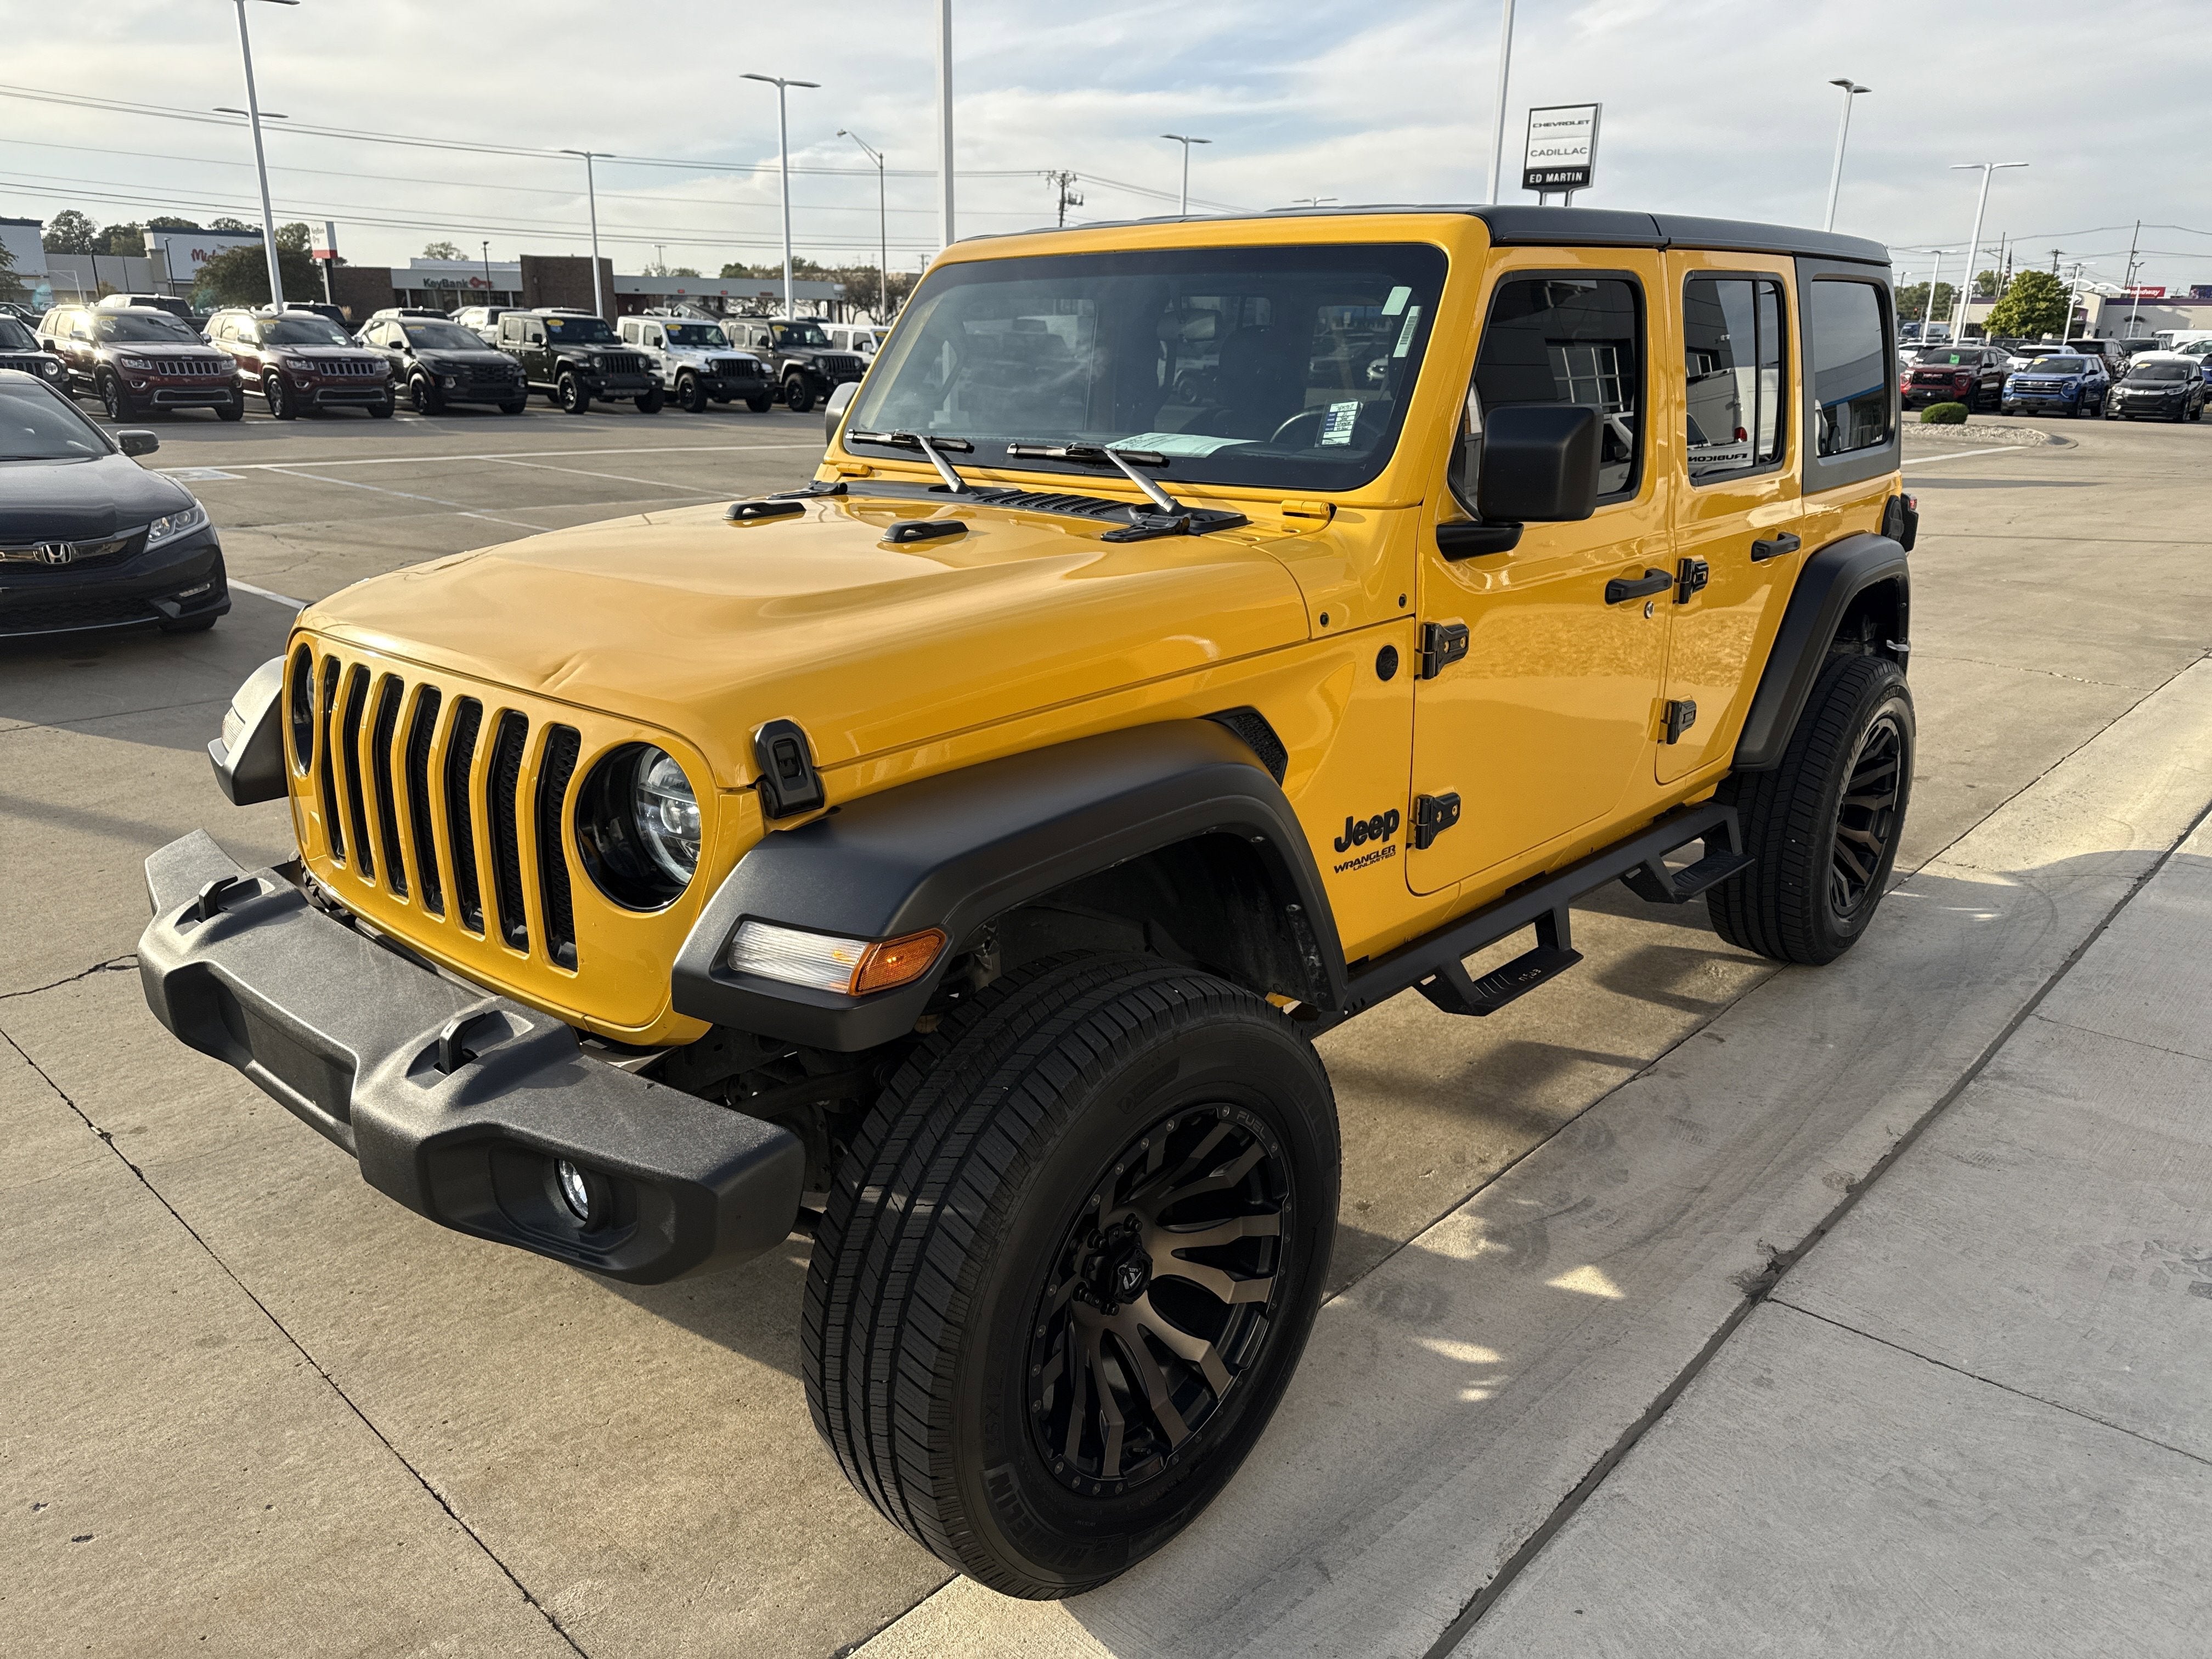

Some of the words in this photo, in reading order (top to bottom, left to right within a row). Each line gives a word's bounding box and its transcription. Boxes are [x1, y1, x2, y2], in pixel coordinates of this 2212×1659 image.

[1532, 120, 1590, 128] CHEVROLET
[1531, 147, 1588, 157] CADILLAC
[1529, 173, 1542, 184] ED
[1545, 171, 1583, 183] MARTIN
[423, 278, 469, 290] KeyBank
[1334, 809, 1400, 853] Jeep
[1334, 844, 1396, 874] WRANGLER
[1353, 851, 1396, 871] UNLIMITED
[1237, 1110, 1266, 1139] FUEL
[988, 1472, 1089, 1568] MICHELIN
